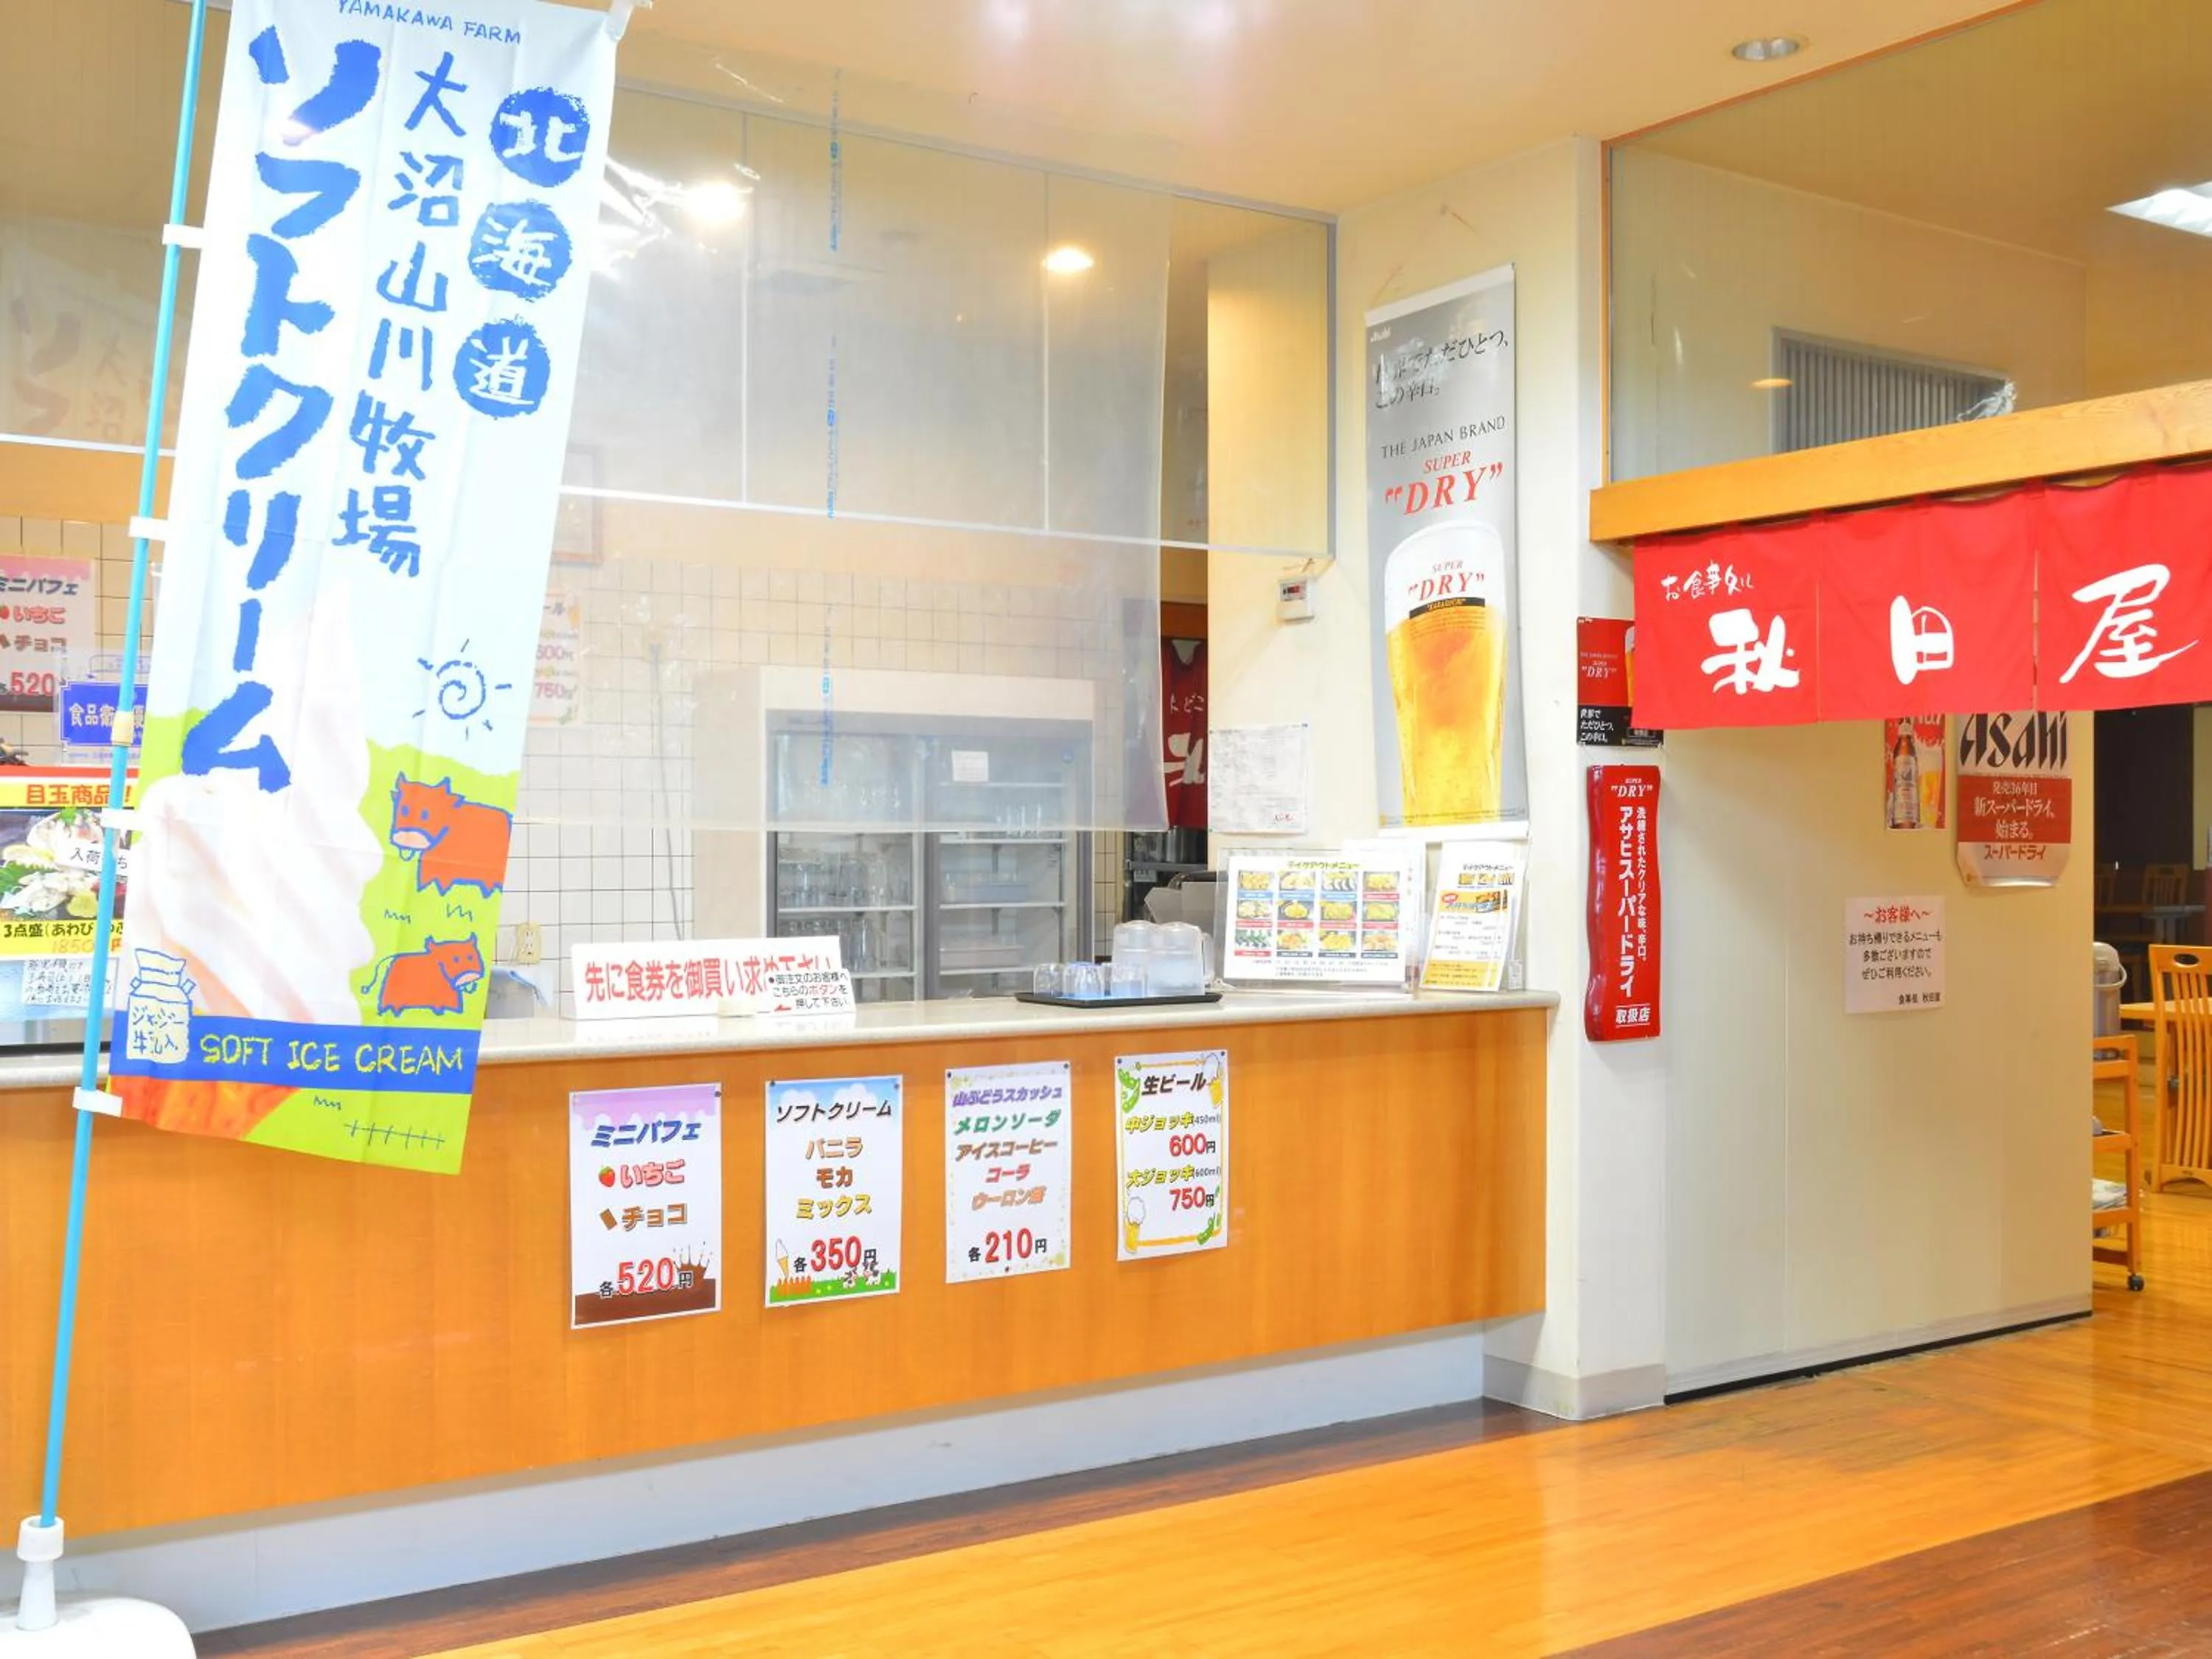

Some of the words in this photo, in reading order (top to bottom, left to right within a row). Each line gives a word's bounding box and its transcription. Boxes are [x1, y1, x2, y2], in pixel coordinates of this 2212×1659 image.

[338, 0, 453, 31] YAMAKAWA
[464, 21, 521, 44] FARM
[331, 51, 468, 577] 大沼山川牧場
[181, 25, 381, 793] ソフトクリーム
[1381, 442, 1405, 459] THE
[1410, 429, 1454, 451] JAPAN
[1459, 415, 1506, 440] BRAND
[1423, 450, 1472, 474] SUPER
[1960, 712, 2067, 771] Asahi
[1983, 844, 2047, 860] スーパードライ
[1618, 805, 1637, 999] アサヒスーパードライ
[1615, 1006, 1650, 1024] 取扱店
[201, 1033, 273, 1066] SOFT
[287, 1040, 341, 1071] ICE
[355, 1043, 463, 1075] CREAM
[1141, 1071, 1207, 1096] 生ビール
[776, 1099, 892, 1124] ソフトクリーム
[953, 1108, 1062, 1136] メロンソーダ
[591, 1119, 702, 1148] ミニパフェ
[804, 1137, 864, 1160] バニラ
[955, 1138, 1058, 1162] アイスコーヒー
[620, 1159, 686, 1189] いちご
[815, 1166, 854, 1189] モカ
[986, 1163, 1031, 1183] コーラ
[621, 1202, 689, 1231] チョコ
[796, 1193, 873, 1221] ミックス
